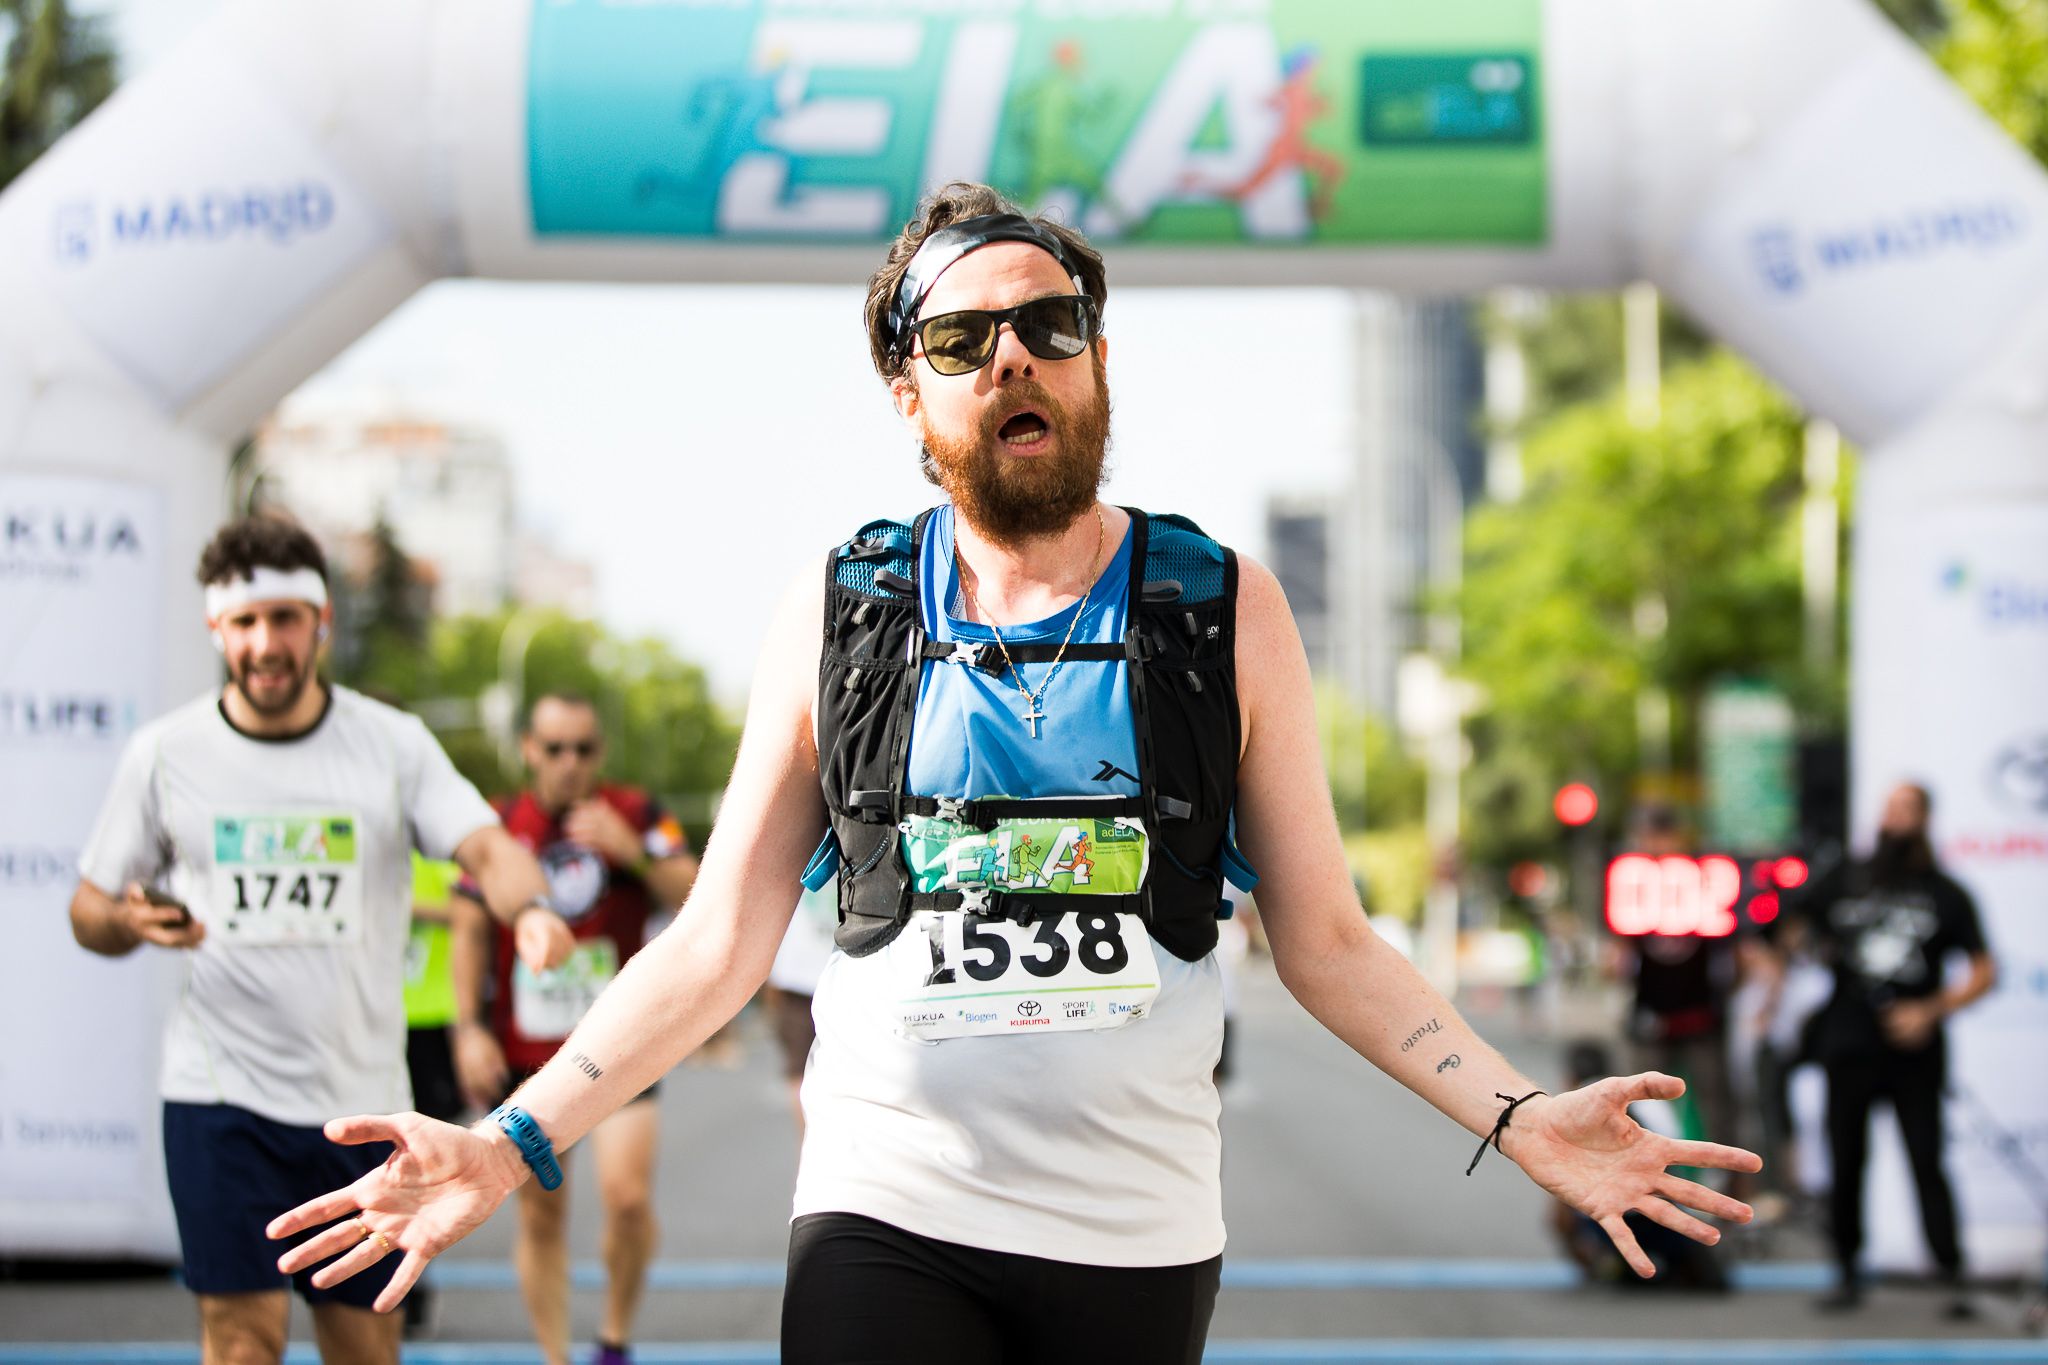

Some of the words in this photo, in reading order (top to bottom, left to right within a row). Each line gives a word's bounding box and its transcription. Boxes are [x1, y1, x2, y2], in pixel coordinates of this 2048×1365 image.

[112, 182, 337, 245] MADRID
[1101, 827, 1136, 838] adELA
[946, 826, 1090, 890] ELA
[232, 872, 341, 911] 1747
[919, 911, 1129, 988] 1538
[1062, 1001, 1089, 1010] SPORT
[1066, 1009, 1087, 1018] LIFE
[904, 1013, 945, 1022] MUKUA
[965, 1012, 998, 1023] Biogen
[1401, 1018, 1444, 1053] Trasto
[1437, 1054, 1461, 1074] Coco
